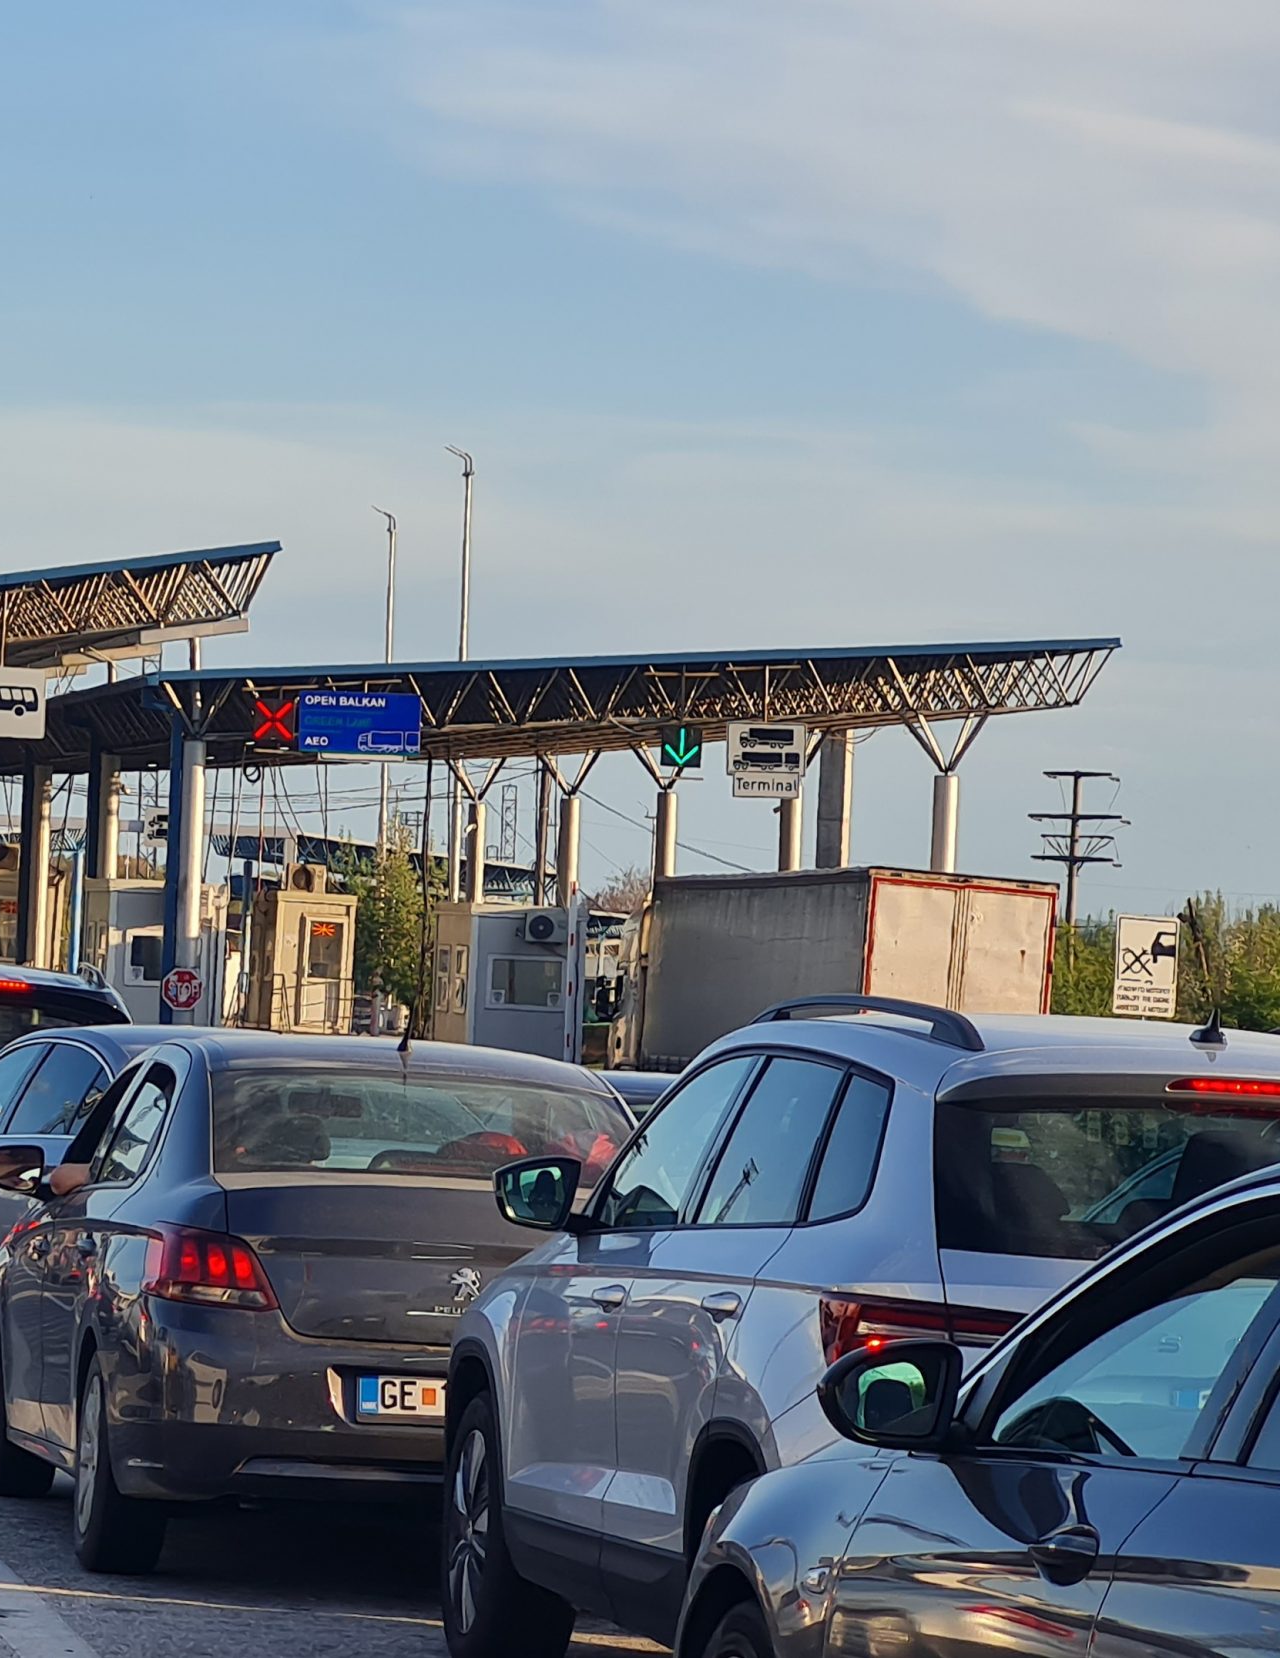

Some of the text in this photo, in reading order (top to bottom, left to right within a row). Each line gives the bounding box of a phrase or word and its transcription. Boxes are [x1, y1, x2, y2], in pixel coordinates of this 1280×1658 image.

[305, 695, 386, 707] OPEN BALKAN
[304, 736, 329, 746] AEO
[736, 777, 797, 792] Terminal
[381, 1380, 418, 1410] GE
